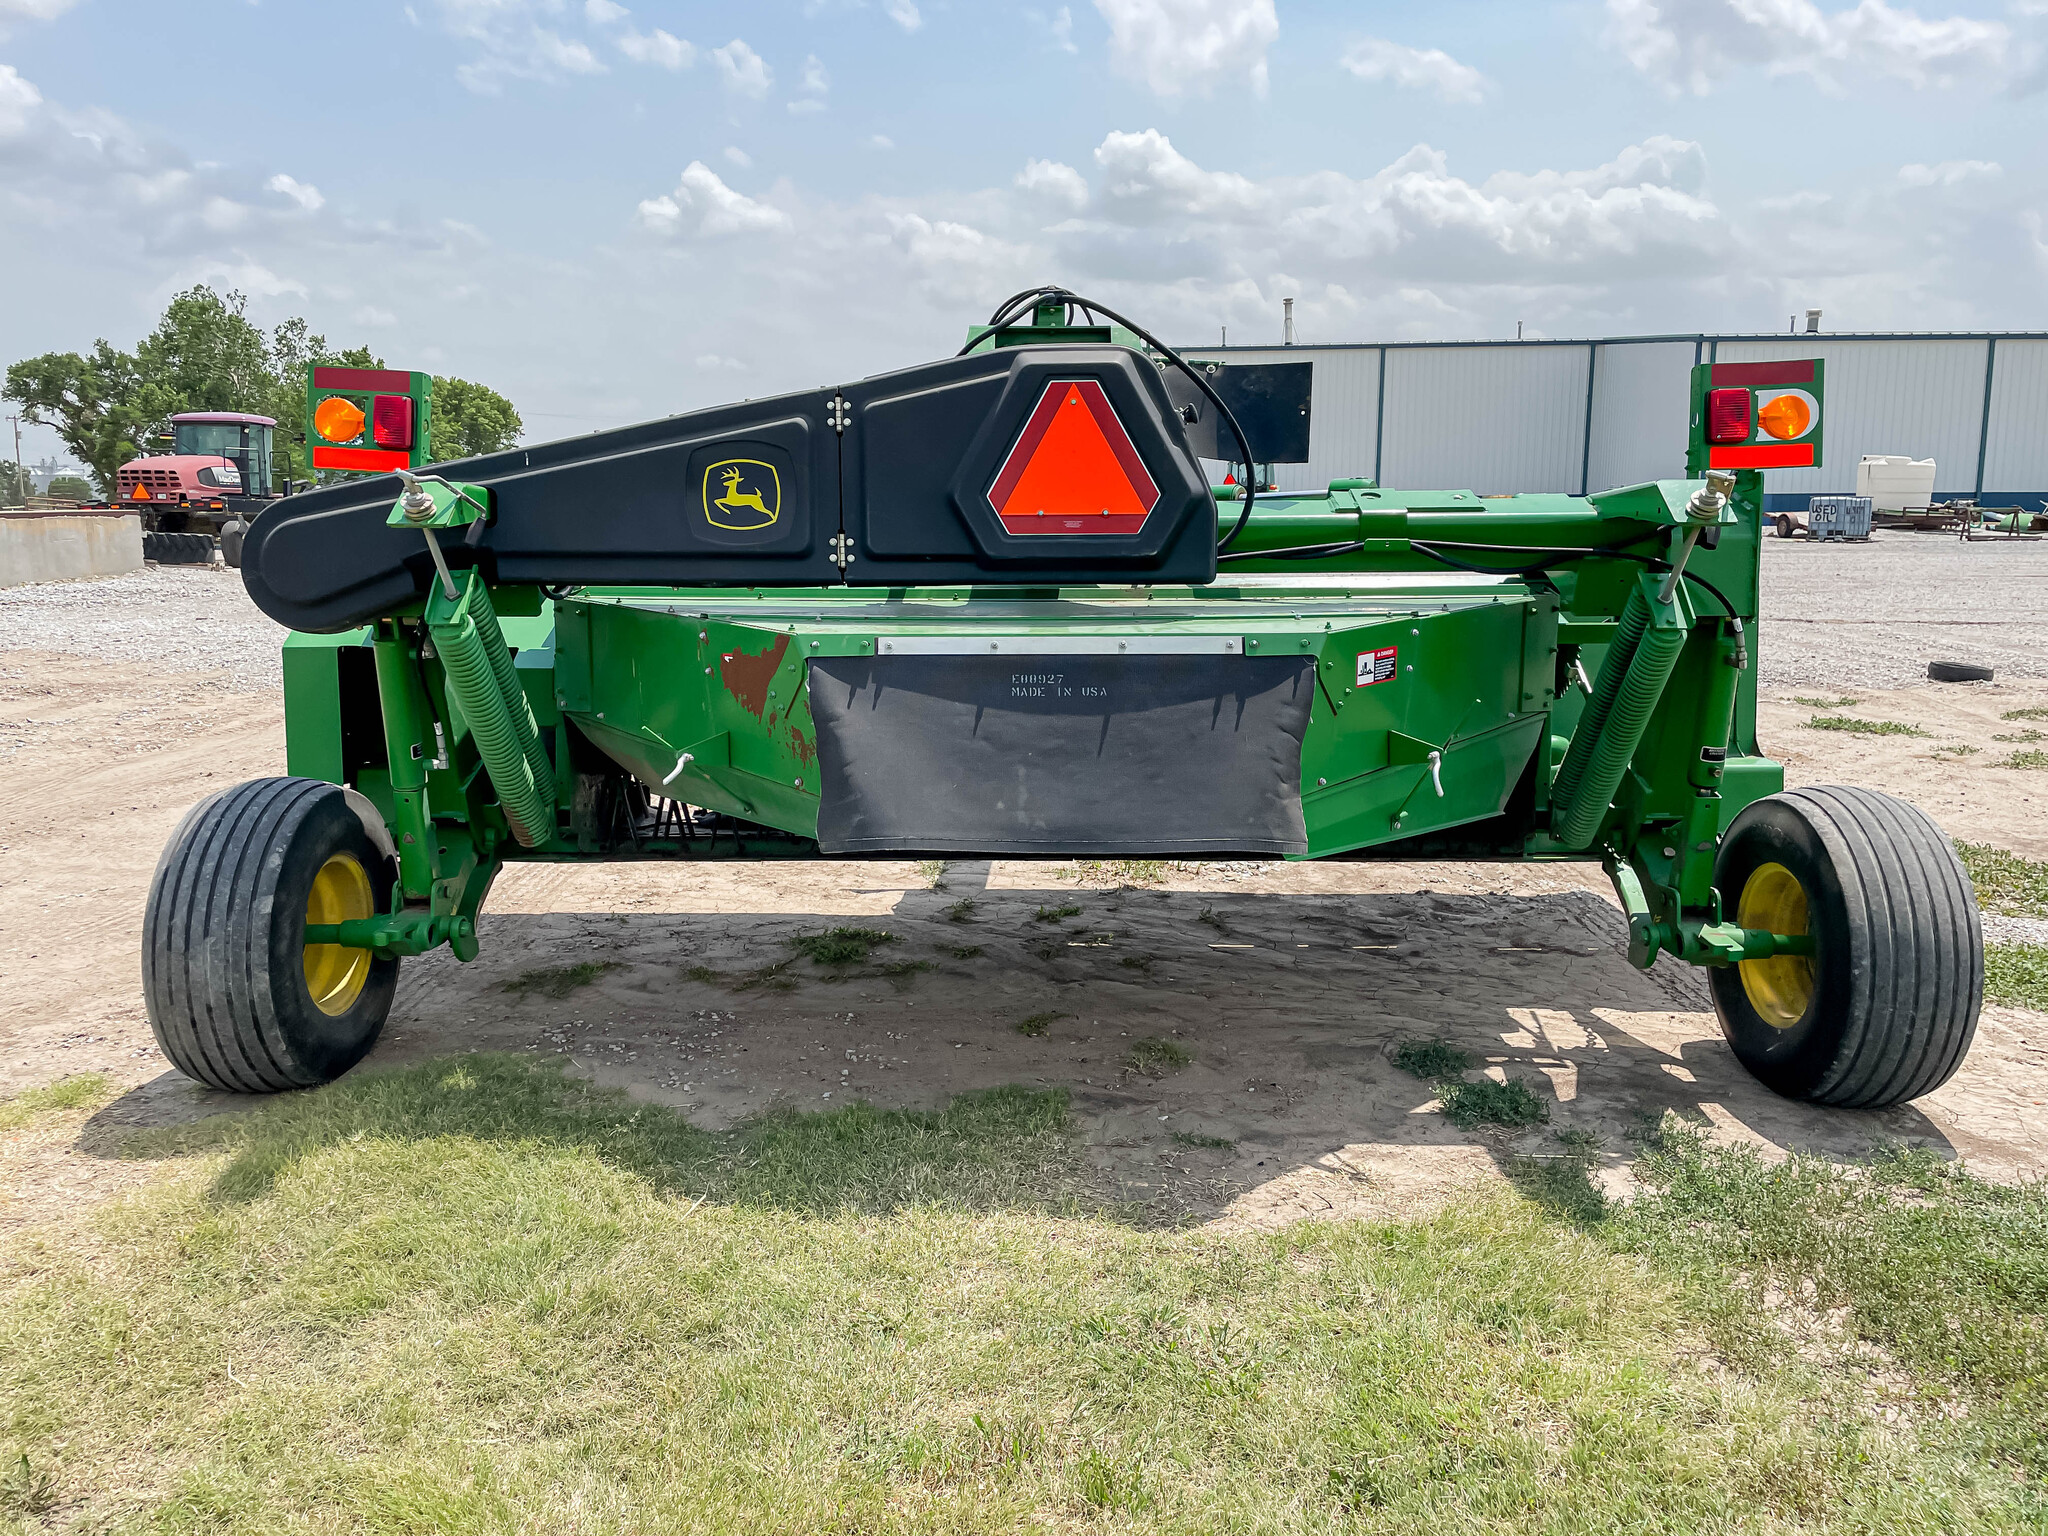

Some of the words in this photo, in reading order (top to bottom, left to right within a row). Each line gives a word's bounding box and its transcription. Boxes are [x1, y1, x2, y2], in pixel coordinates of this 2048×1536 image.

[1811, 504, 1837, 515] USED
[1814, 513, 1832, 523] OIL
[1011, 687, 1046, 697] MADE
[1057, 687, 1072, 697] IN
[1081, 687, 1107, 697] USA
